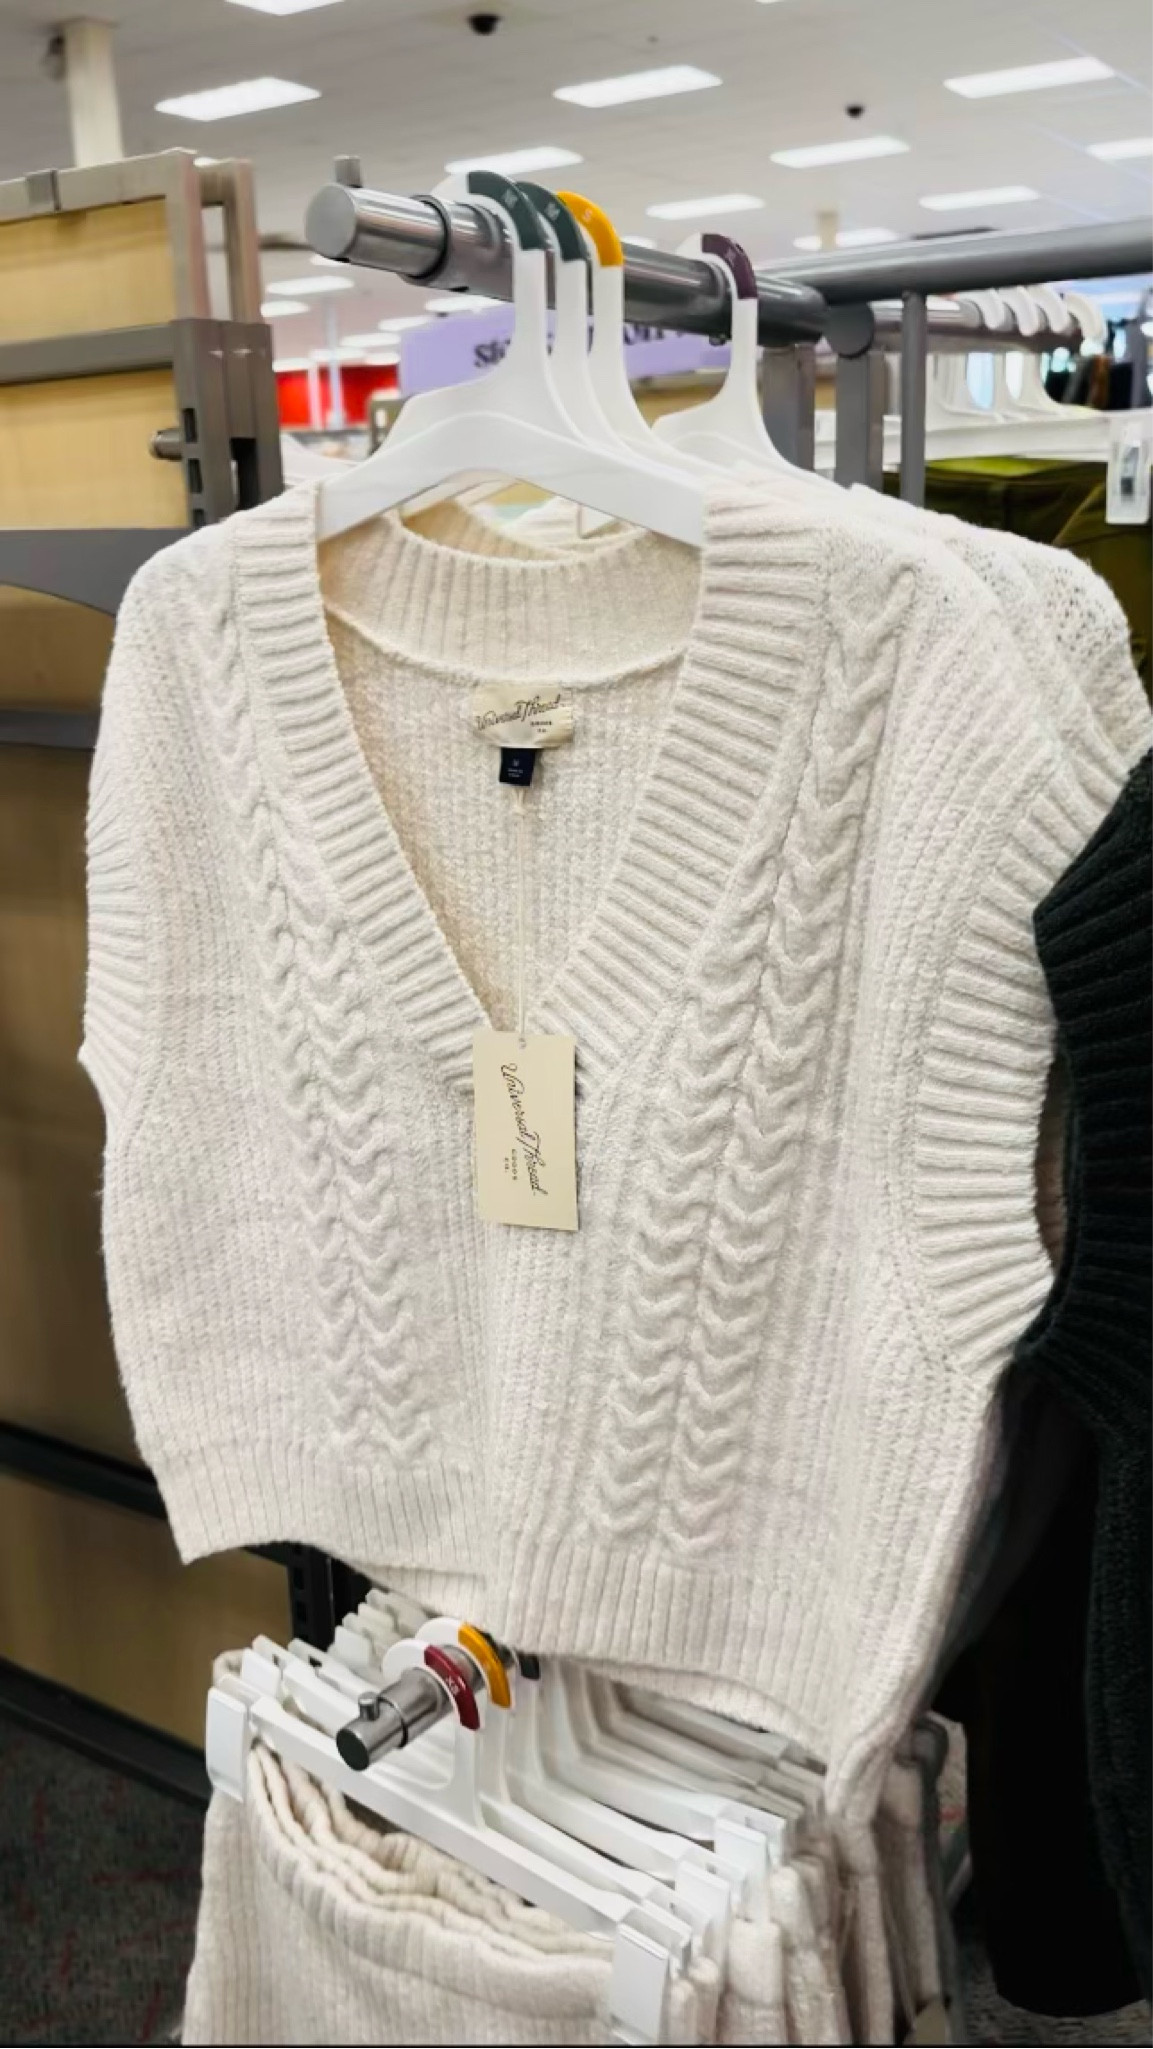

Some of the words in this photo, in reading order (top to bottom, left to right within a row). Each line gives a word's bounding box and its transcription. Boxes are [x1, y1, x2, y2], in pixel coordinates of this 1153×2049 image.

[475, 706, 522, 731] Universal
[515, 693, 564, 722] Thread
[501, 1063, 536, 1141] Universal
[515, 1131, 549, 1197] Thread
